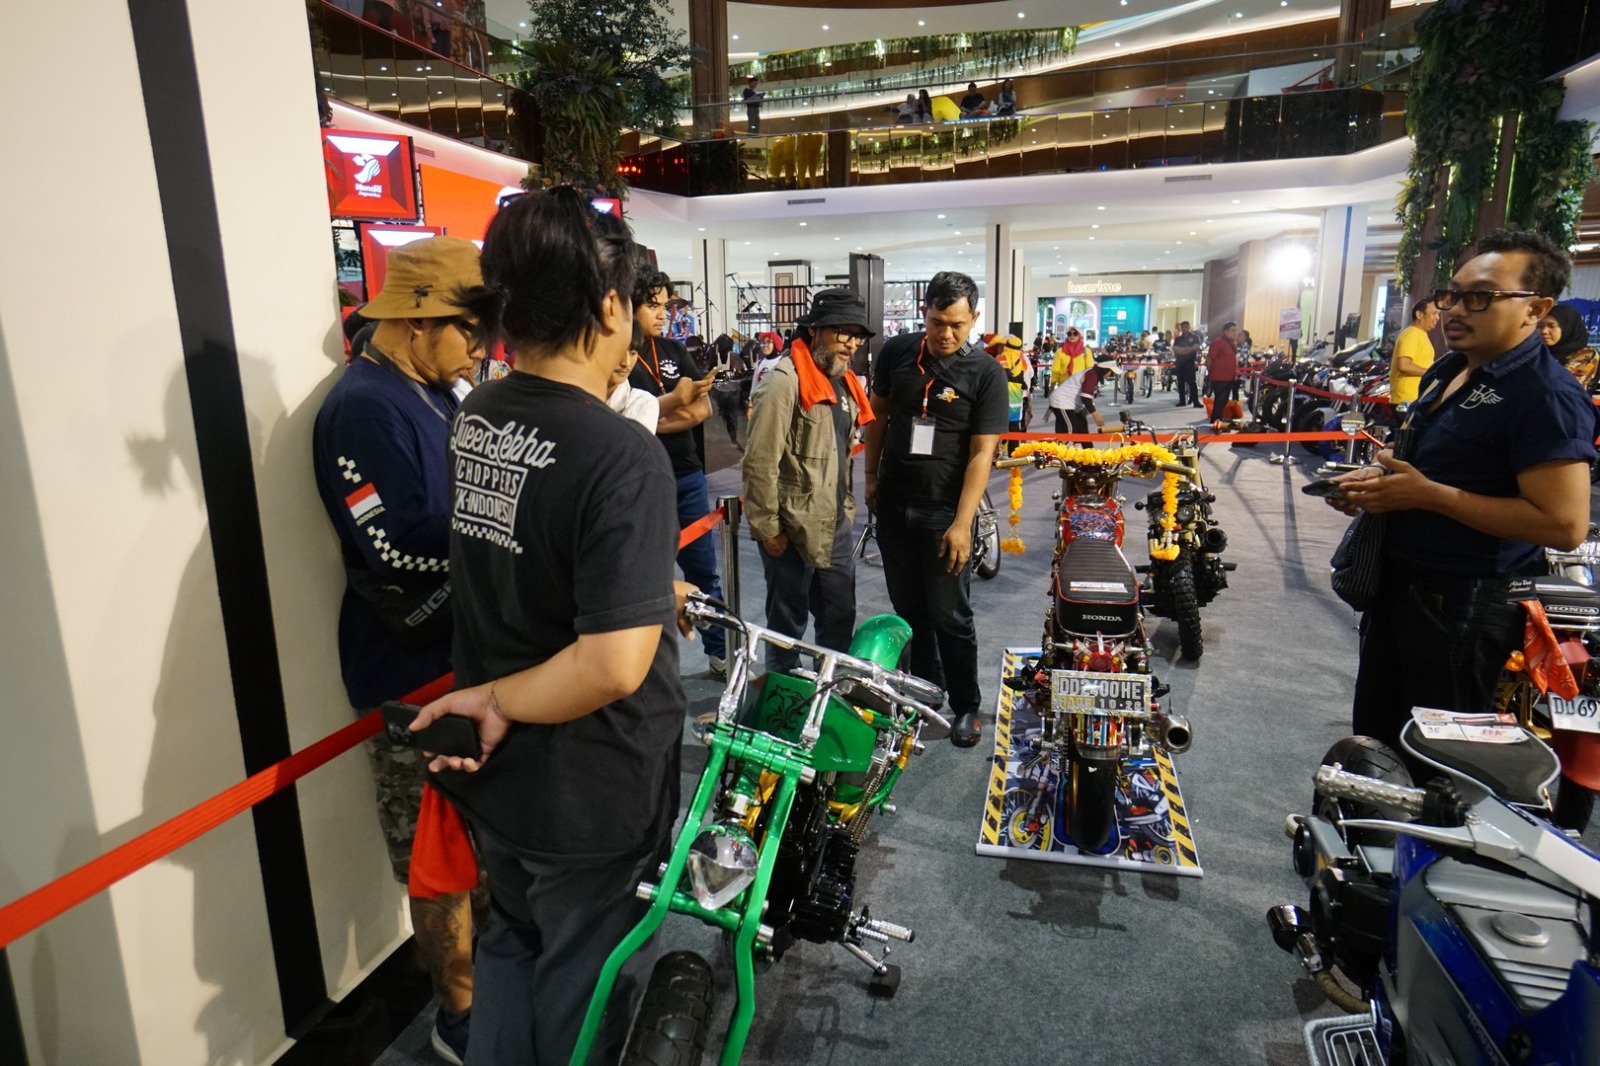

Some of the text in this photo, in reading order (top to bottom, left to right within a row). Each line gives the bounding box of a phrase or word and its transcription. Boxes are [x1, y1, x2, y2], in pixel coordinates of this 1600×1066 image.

[457, 458, 520, 496] CHOPPERS
[1548, 605, 1596, 614] HONDA
[1081, 614, 1123, 622] HONDA
[1059, 677, 1080, 695] DD
[1121, 681, 1142, 700] HE
